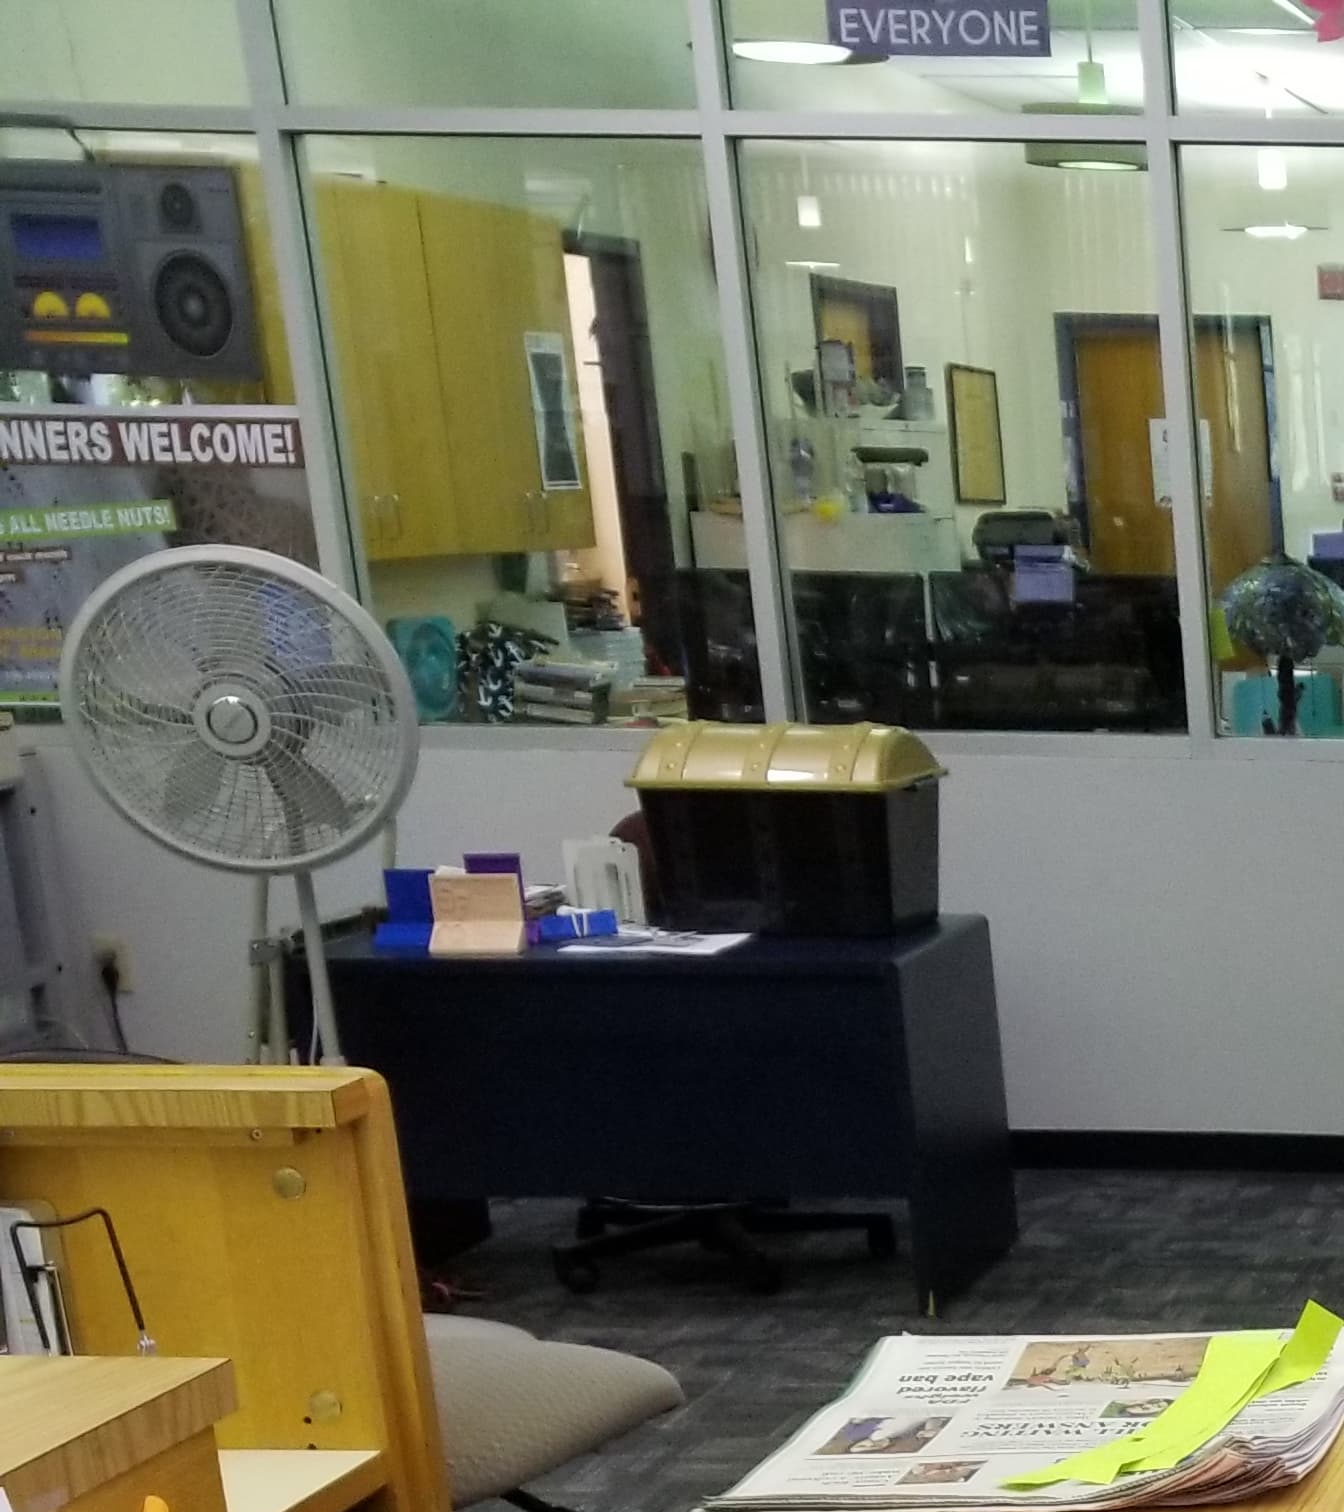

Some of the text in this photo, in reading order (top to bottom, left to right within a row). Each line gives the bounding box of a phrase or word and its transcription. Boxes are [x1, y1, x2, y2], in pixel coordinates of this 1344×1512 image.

[838, 7, 1041, 46] EVERYONE
[119, 422, 296, 464] WELCOME!
[10, 514, 42, 534] ALL
[117, 505, 170, 528] NUTS!
[896, 1385, 986, 1395] flavored
[899, 1373, 993, 1382] vape ban
